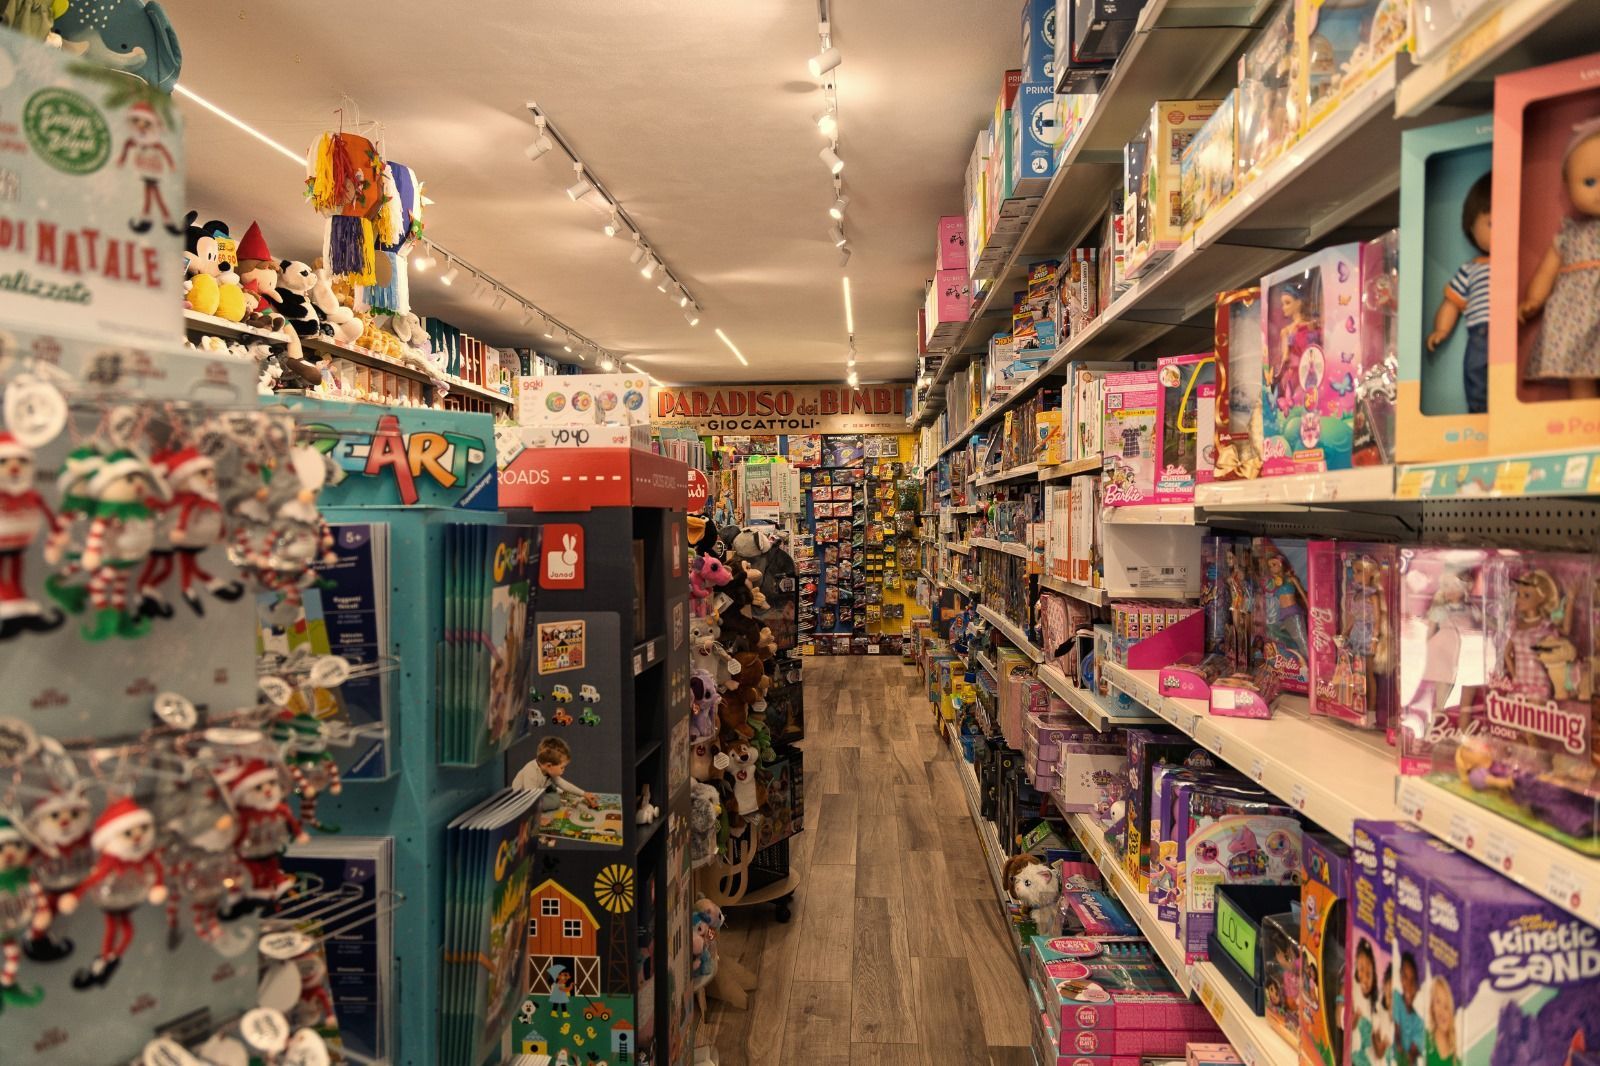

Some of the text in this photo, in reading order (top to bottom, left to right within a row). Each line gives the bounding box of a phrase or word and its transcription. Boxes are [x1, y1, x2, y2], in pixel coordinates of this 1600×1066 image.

[36, 217, 162, 289] NATALE
[523, 380, 544, 391] goki
[657, 387, 904, 417] PARADISO dei BIMBI
[496, 469, 550, 485] ROADS
[1104, 483, 1144, 504] Barbie
[345, 531, 362, 544] 5+
[1274, 654, 1299, 670] Barbie
[1486, 690, 1585, 754] twinning
[1490, 725, 1518, 740] LOOKS
